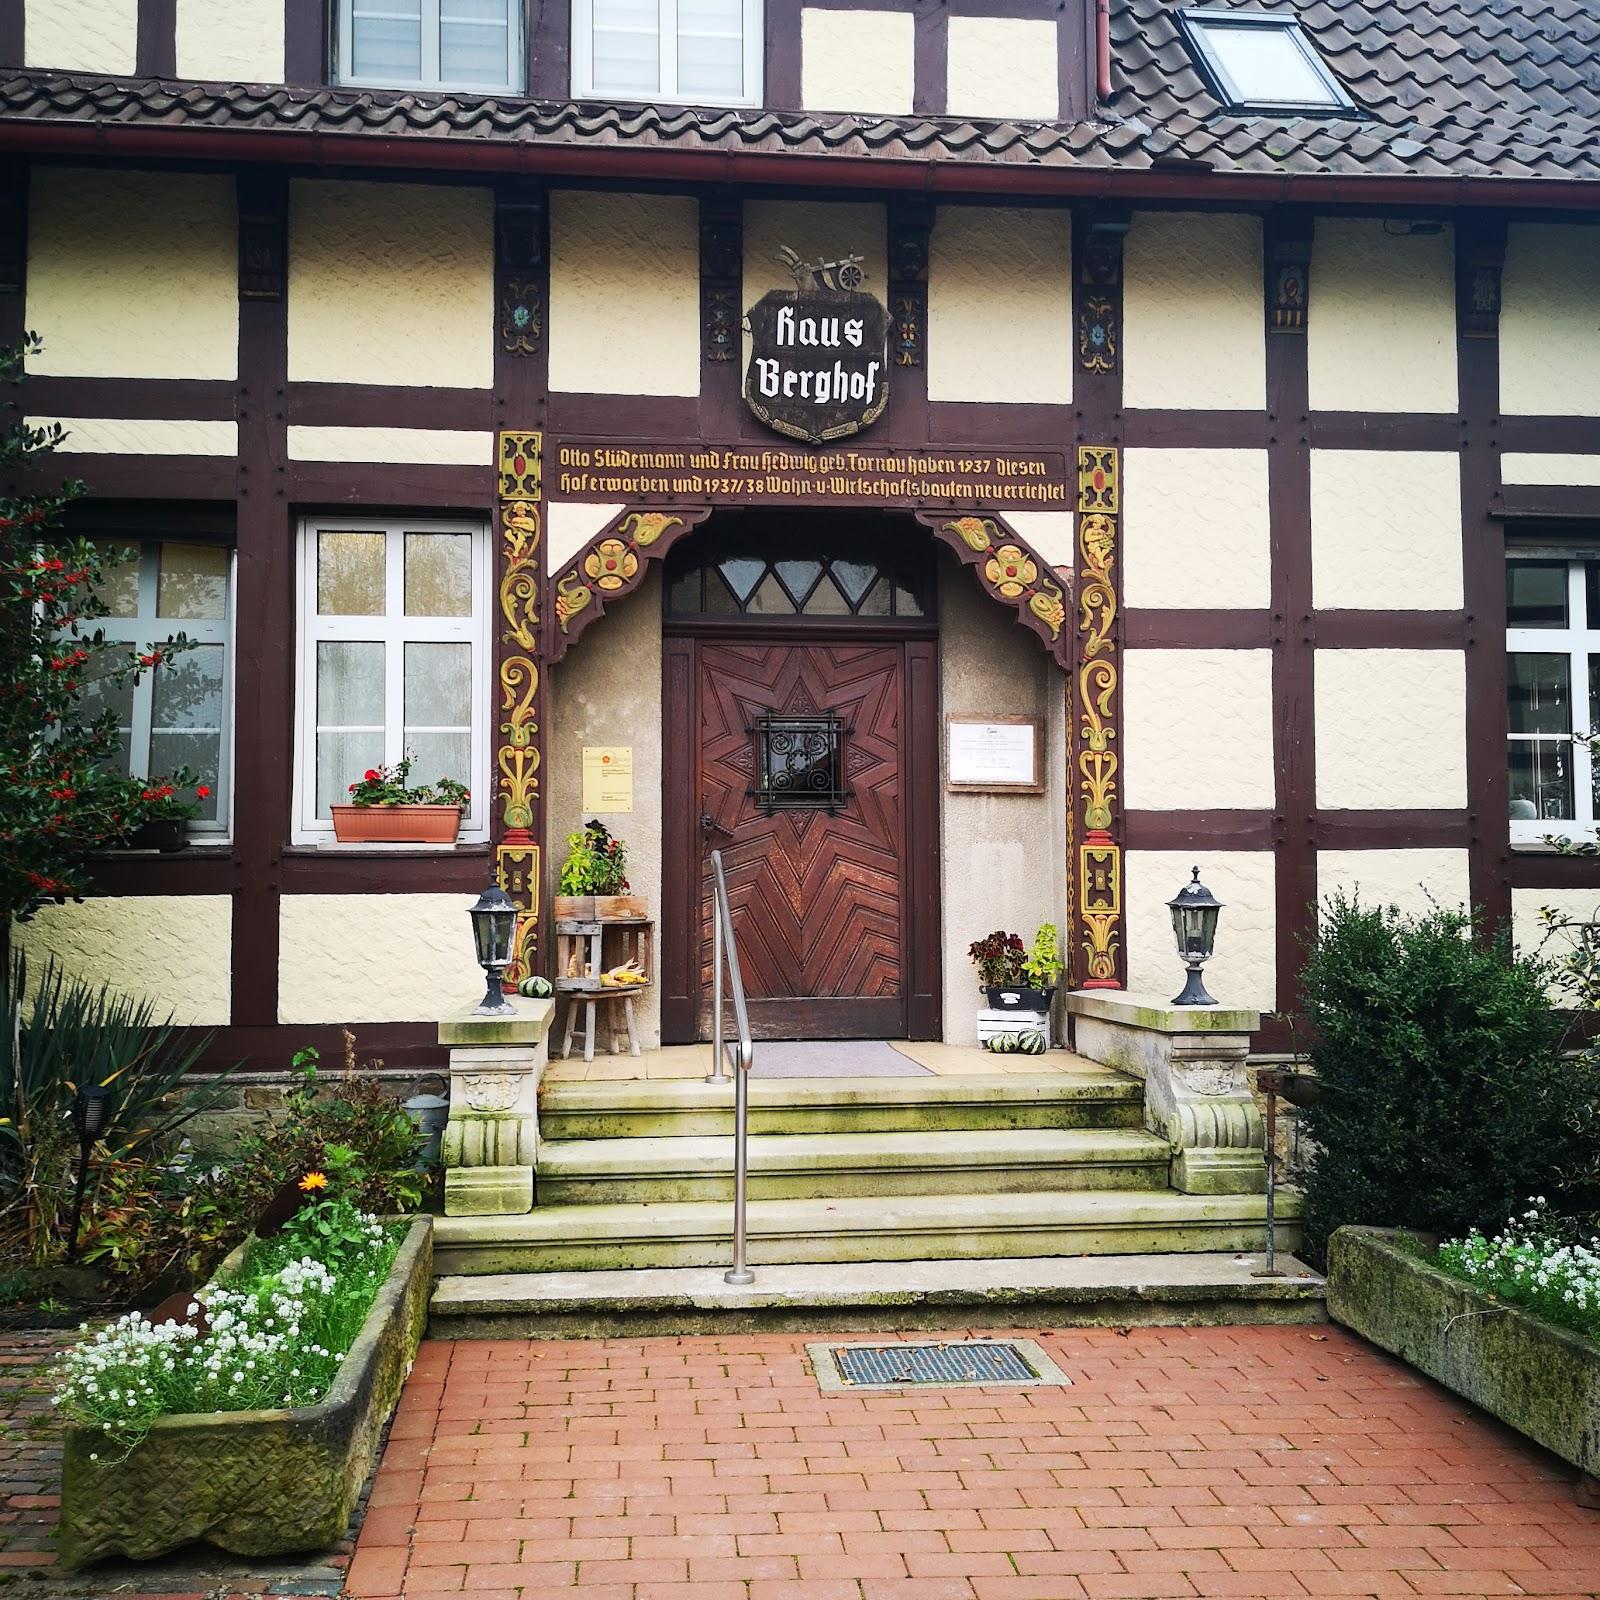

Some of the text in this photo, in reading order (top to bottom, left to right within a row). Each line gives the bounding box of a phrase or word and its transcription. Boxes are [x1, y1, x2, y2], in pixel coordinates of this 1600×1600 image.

[776, 305, 864, 348] Haus
[755, 357, 880, 406] Berghof
[560, 448, 590, 467] Otto
[594, 449, 686, 469] Stüdemann
[689, 450, 720, 470] und
[722, 451, 760, 471] Frau
[761, 451, 818, 474] Hedwig
[907, 455, 957, 477] haben
[958, 459, 991, 474] 1937
[561, 472, 589, 494] Hof
[590, 475, 670, 493] erworben
[672, 475, 703, 493] und
[704, 478, 764, 493] 1937/38
[974, 483, 1003, 499] neu
[1004, 482, 1065, 503] errichtet
